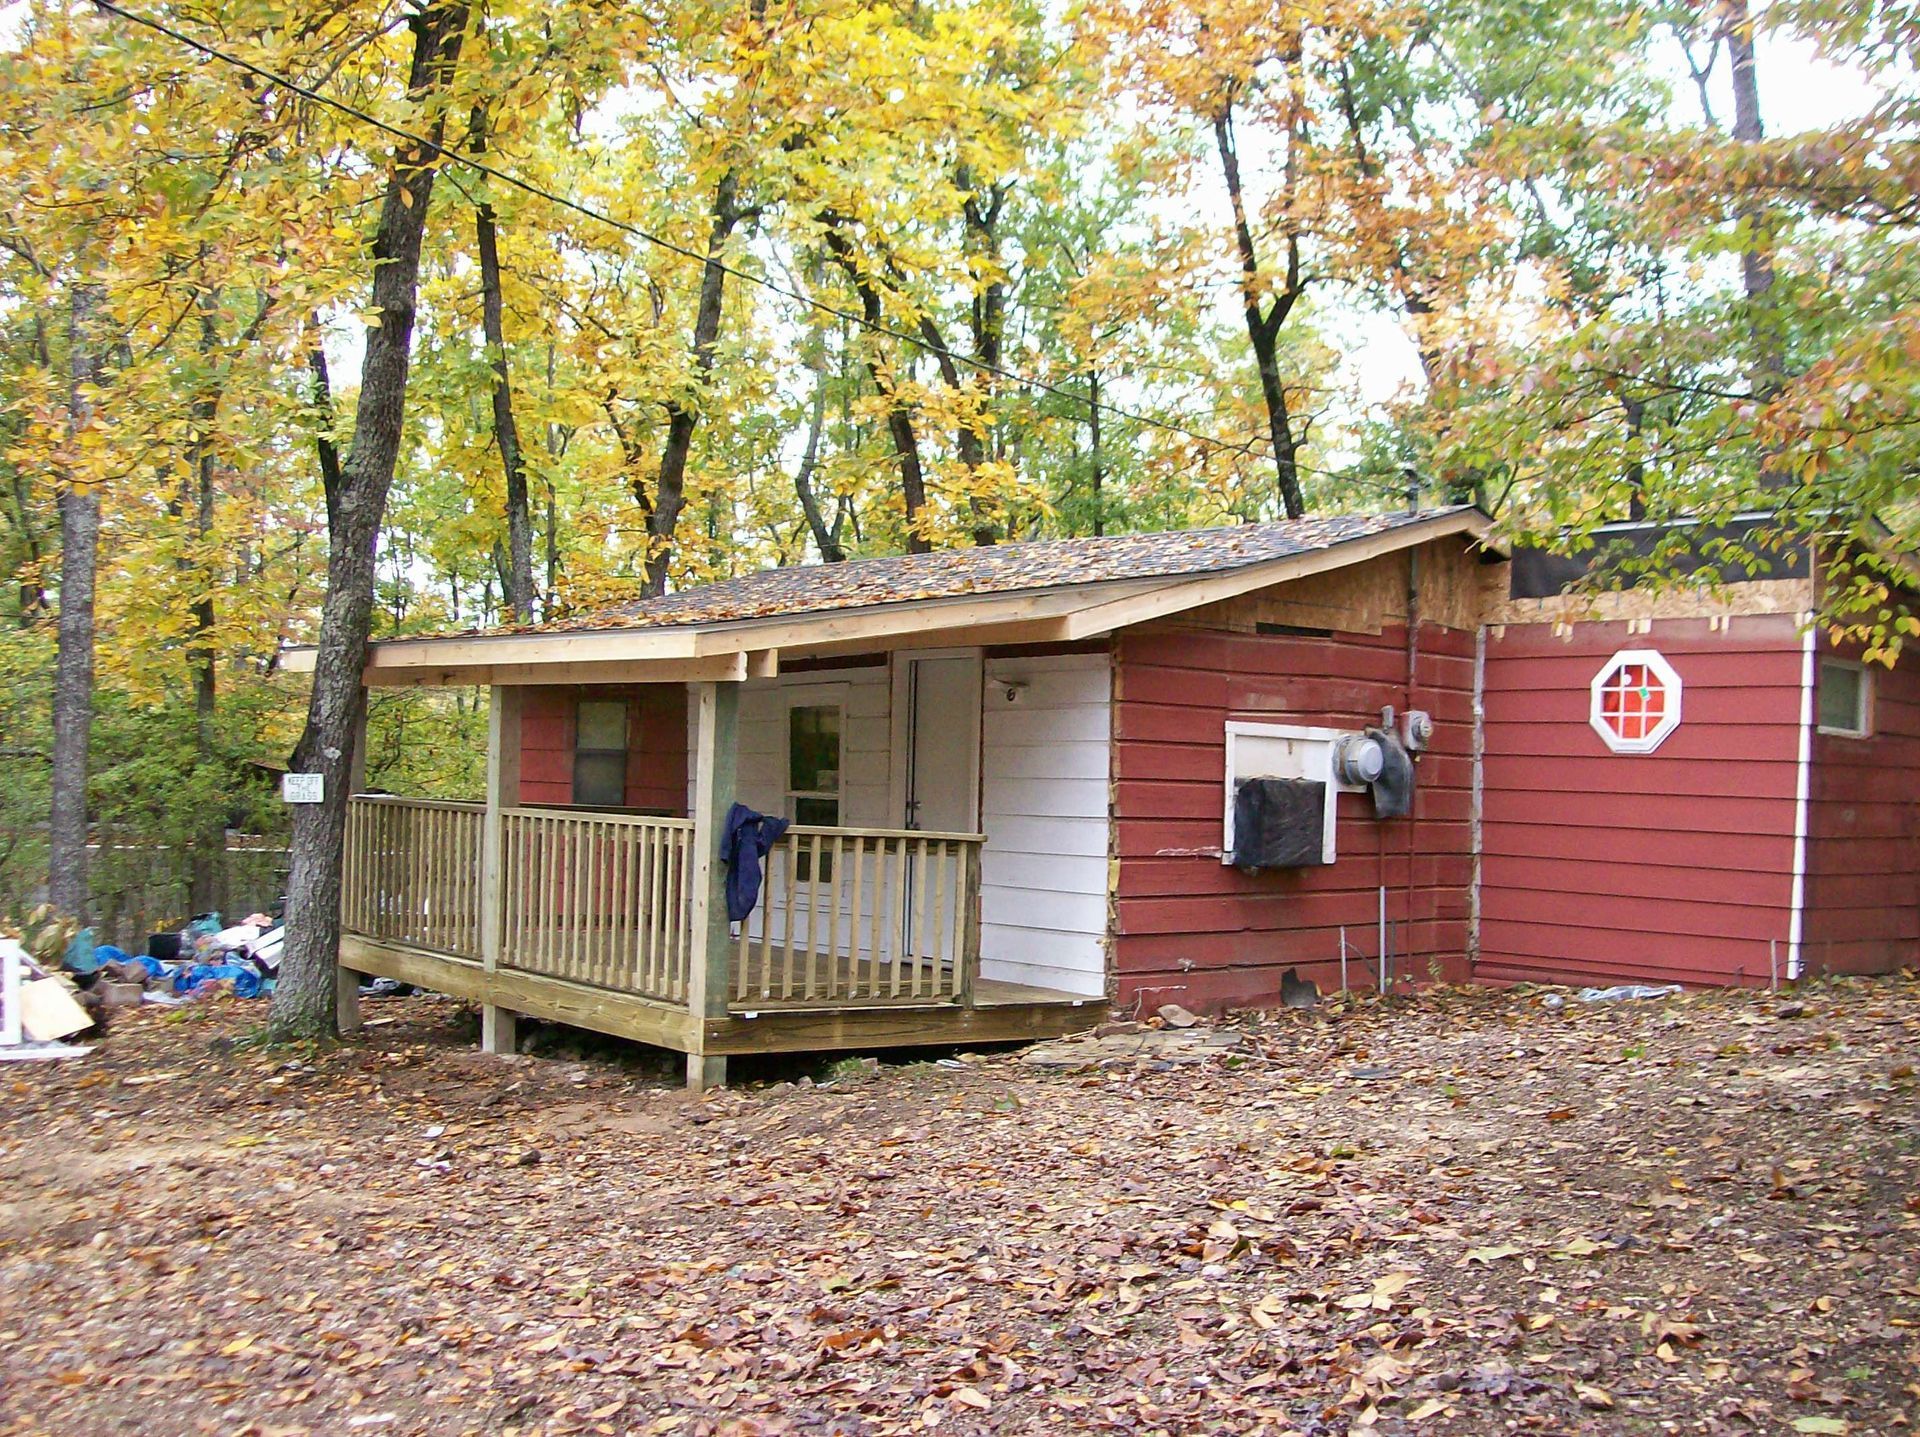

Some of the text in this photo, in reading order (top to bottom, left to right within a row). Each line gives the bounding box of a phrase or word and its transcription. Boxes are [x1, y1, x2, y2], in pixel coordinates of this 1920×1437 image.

[288, 776, 319, 785] KEEP OFF
[290, 791, 318, 801] GRASS
